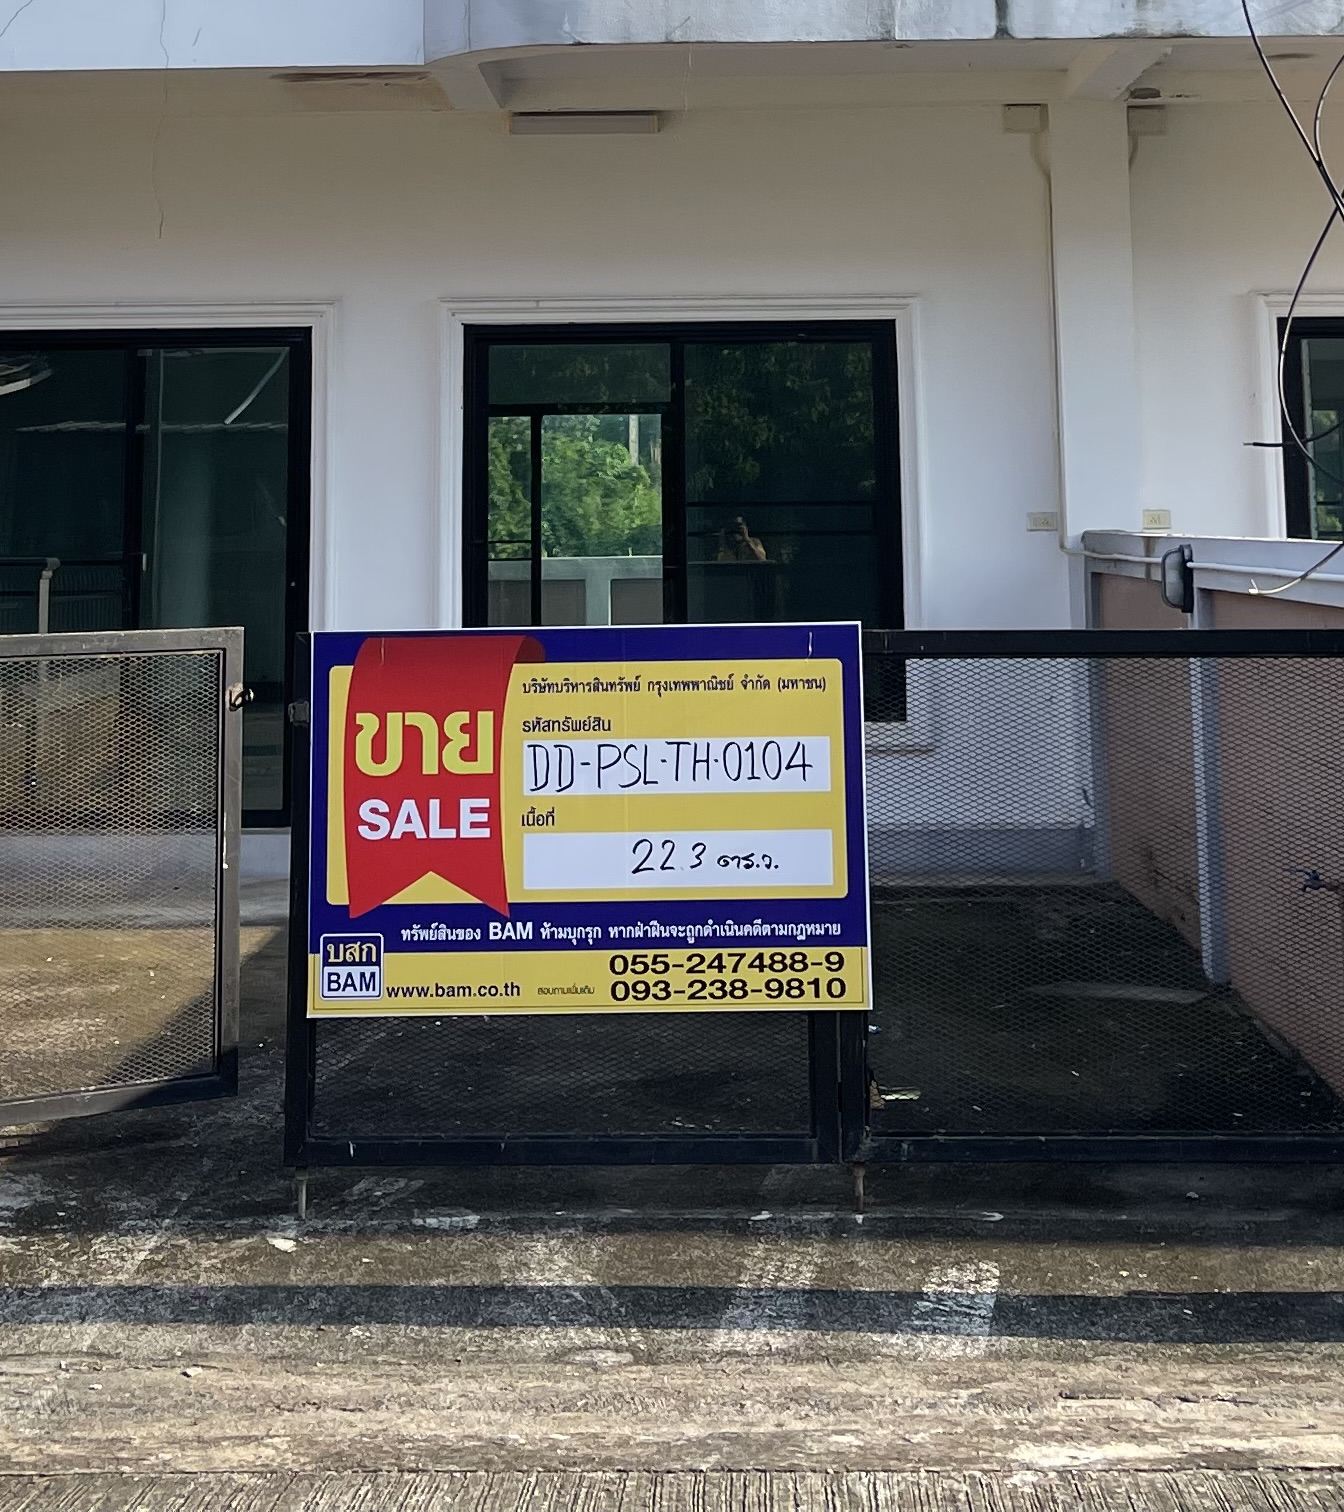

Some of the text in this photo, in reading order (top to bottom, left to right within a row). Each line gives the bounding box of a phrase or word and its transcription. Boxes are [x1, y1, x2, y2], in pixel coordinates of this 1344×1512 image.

[522, 673, 826, 697] บริษัทบริหารสินทรัพย์ กรุงเทพพาณิชย์ จำกัด (มหาชน)
[522, 716, 612, 733] รหัสทรัพย์สิน
[355, 710, 495, 777] ขาย
[357, 798, 491, 840] SALE
[521, 806, 556, 827] เนื้อที่
[401, 918, 841, 945] ทรัพย์สินของ BAM ห้ามบุกรุก หากฝ่าฝืนจะถูกดำเนินคดีตามกฎหมาย
[326, 942, 377, 963] บสก
[609, 951, 845, 975] 055-247488-9
[327, 971, 376, 993] BAM
[386, 982, 521, 998] www.bam.co.th
[611, 977, 846, 1001] 093-238-9810
